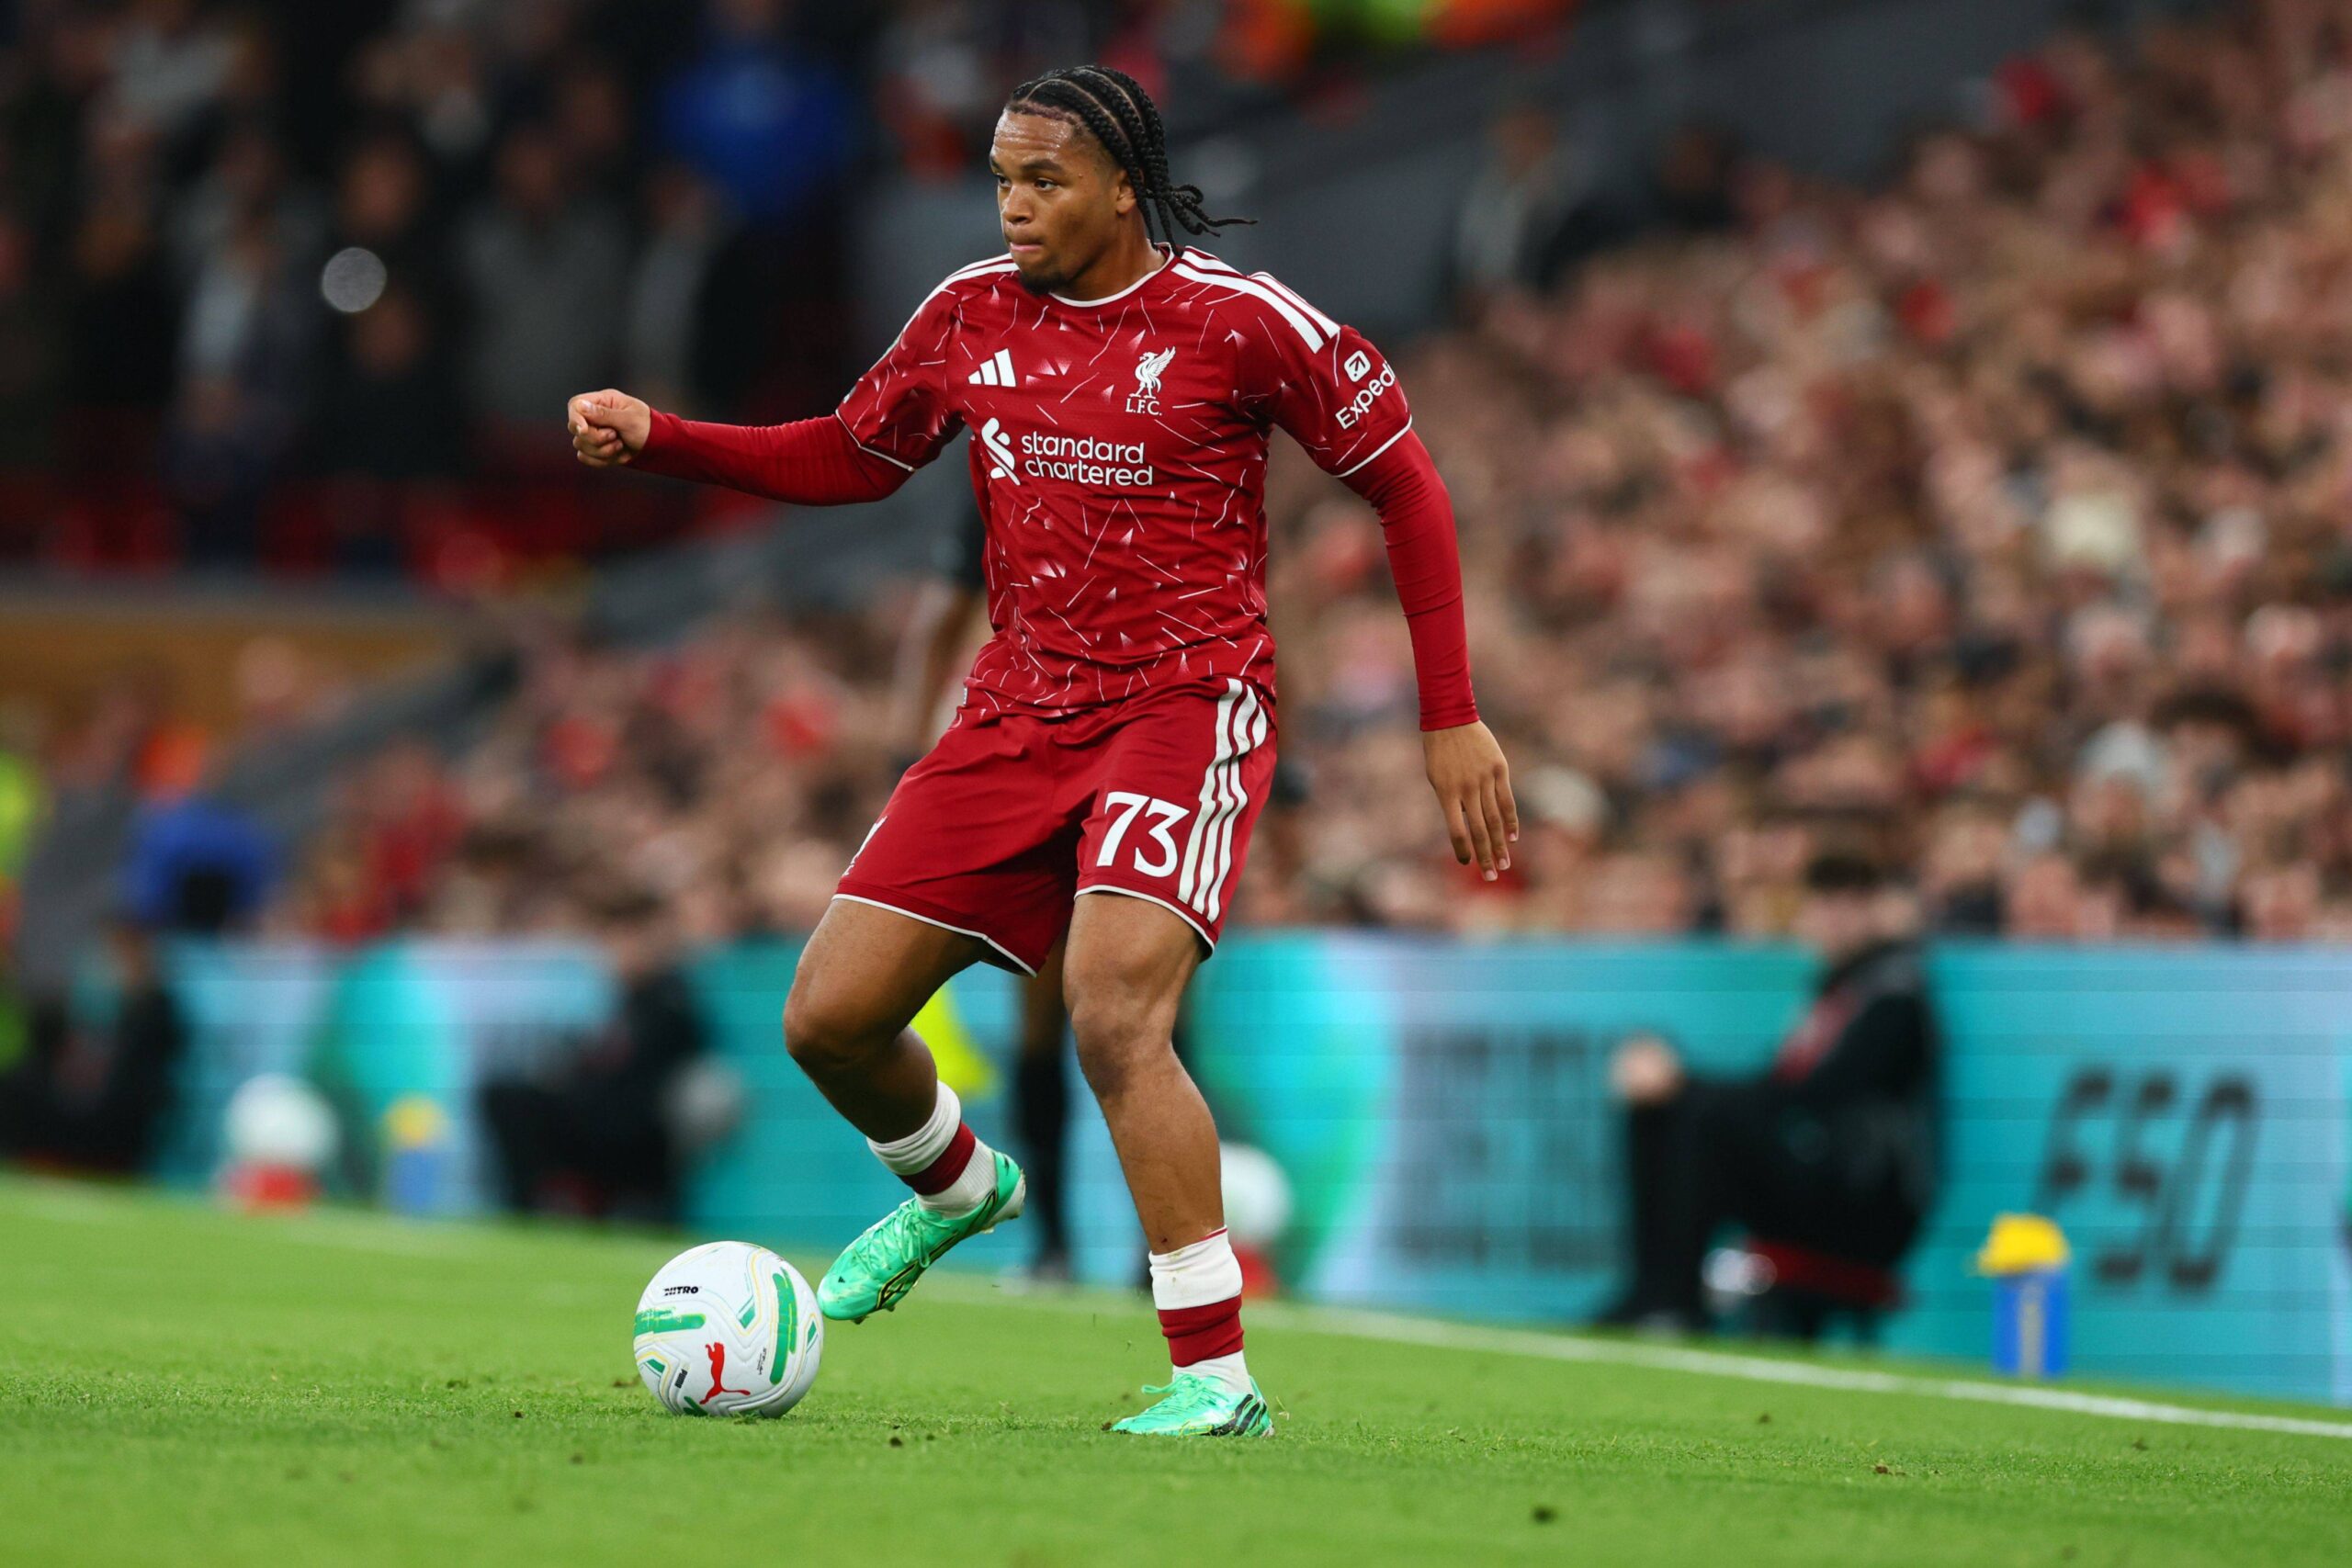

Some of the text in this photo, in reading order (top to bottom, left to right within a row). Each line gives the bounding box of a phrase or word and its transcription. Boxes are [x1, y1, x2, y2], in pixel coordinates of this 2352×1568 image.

[1021, 431, 1145, 464] standard
[1024, 456, 1153, 486] chartered
[1096, 791, 1191, 878] 73
